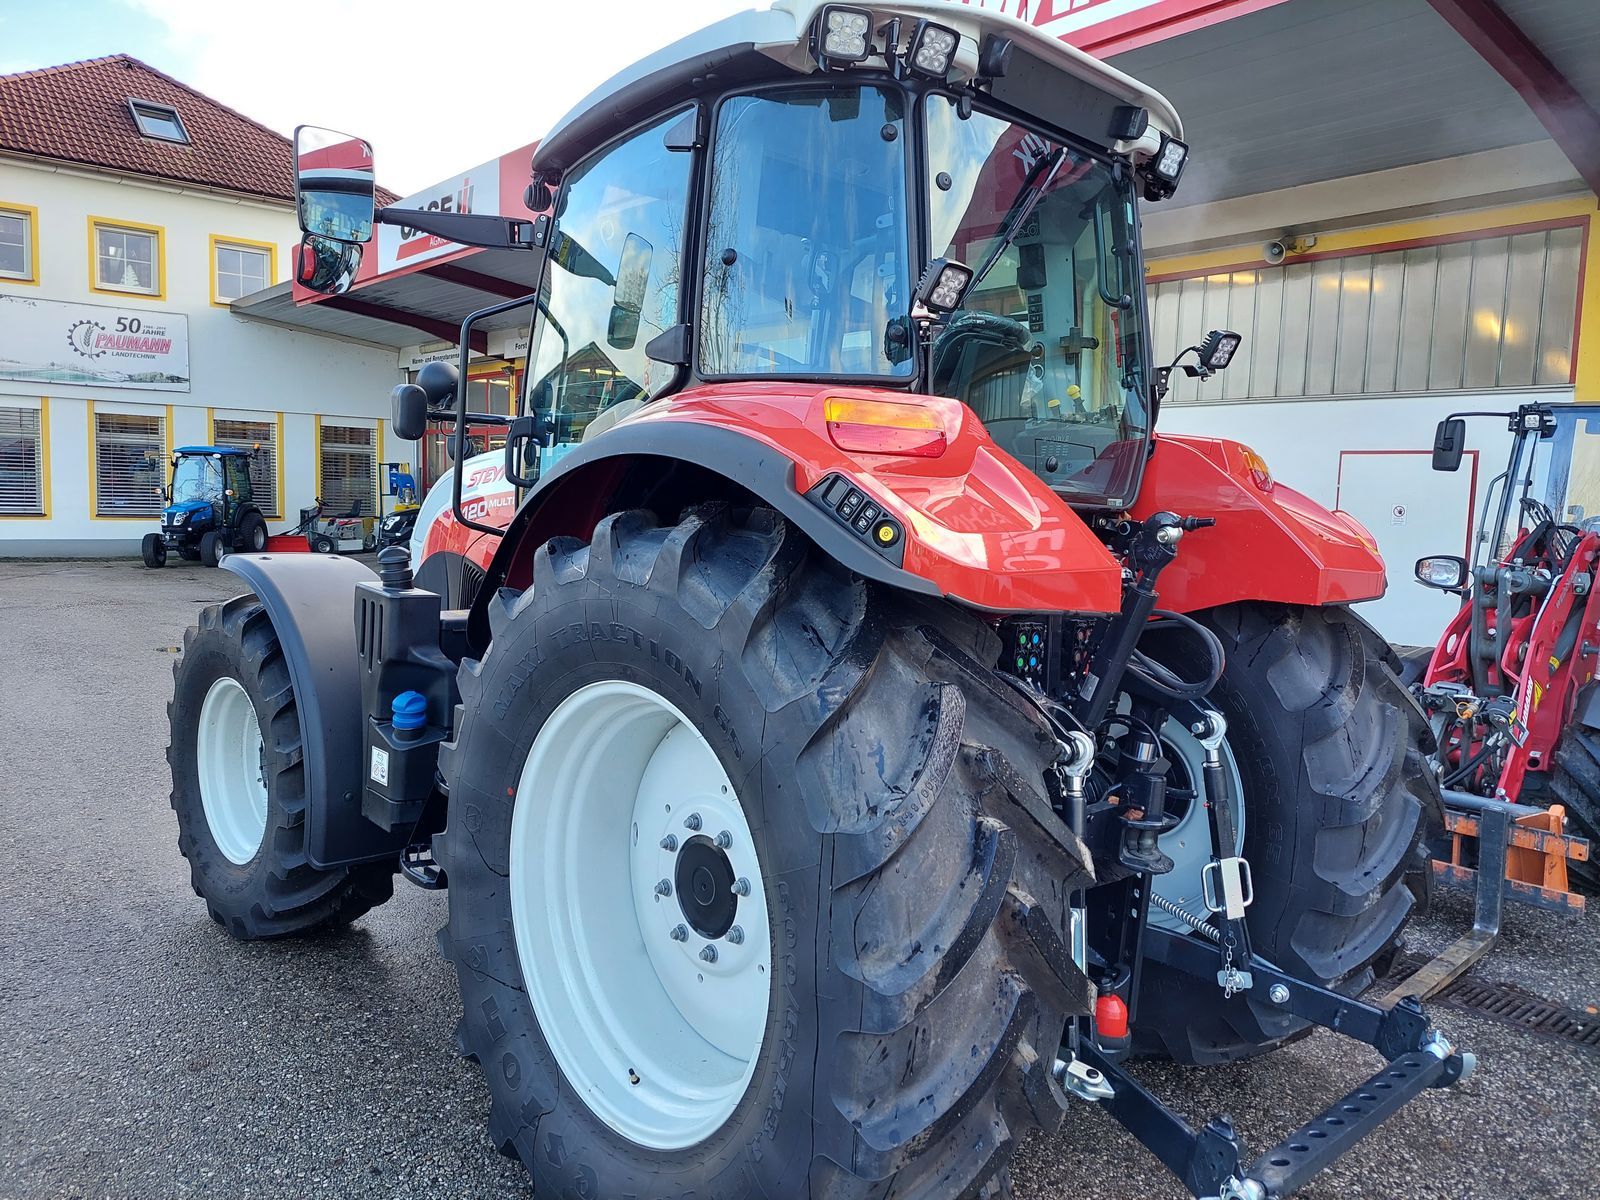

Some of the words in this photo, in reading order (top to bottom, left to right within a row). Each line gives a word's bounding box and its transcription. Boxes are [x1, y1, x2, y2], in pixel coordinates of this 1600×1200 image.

[115, 316, 142, 334] 50
[141, 329, 166, 337] JAHRE
[95, 333, 172, 353] PAUMANN
[111, 351, 157, 360] LANDTECHNIK
[549, 621, 702, 700] TRACTION
